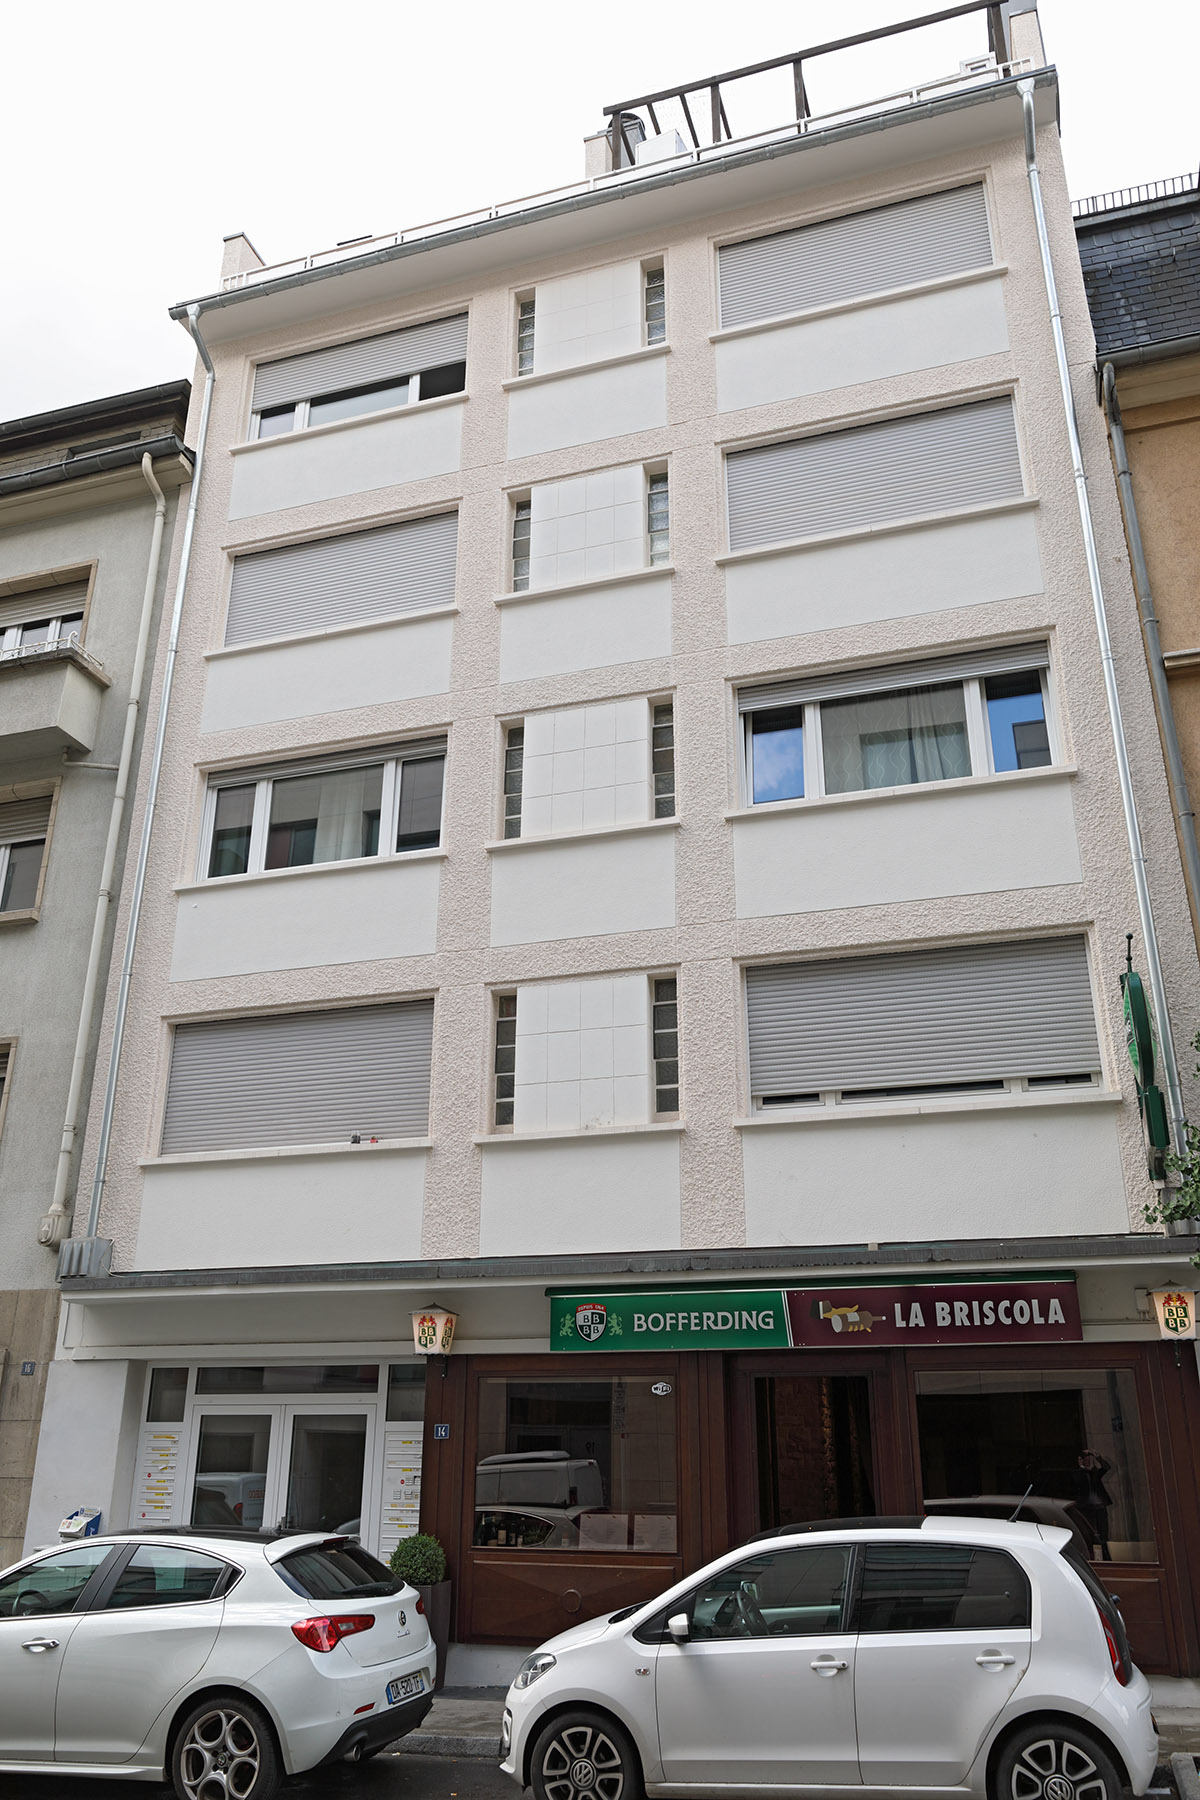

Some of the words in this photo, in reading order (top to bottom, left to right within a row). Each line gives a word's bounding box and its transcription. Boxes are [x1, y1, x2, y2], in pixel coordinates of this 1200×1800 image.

[633, 1311, 775, 1332] BOFFERDING
[894, 1302, 926, 1328] LA
[935, 1298, 1066, 1327] BRISCOLA
[438, 1426, 446, 1437] 14
